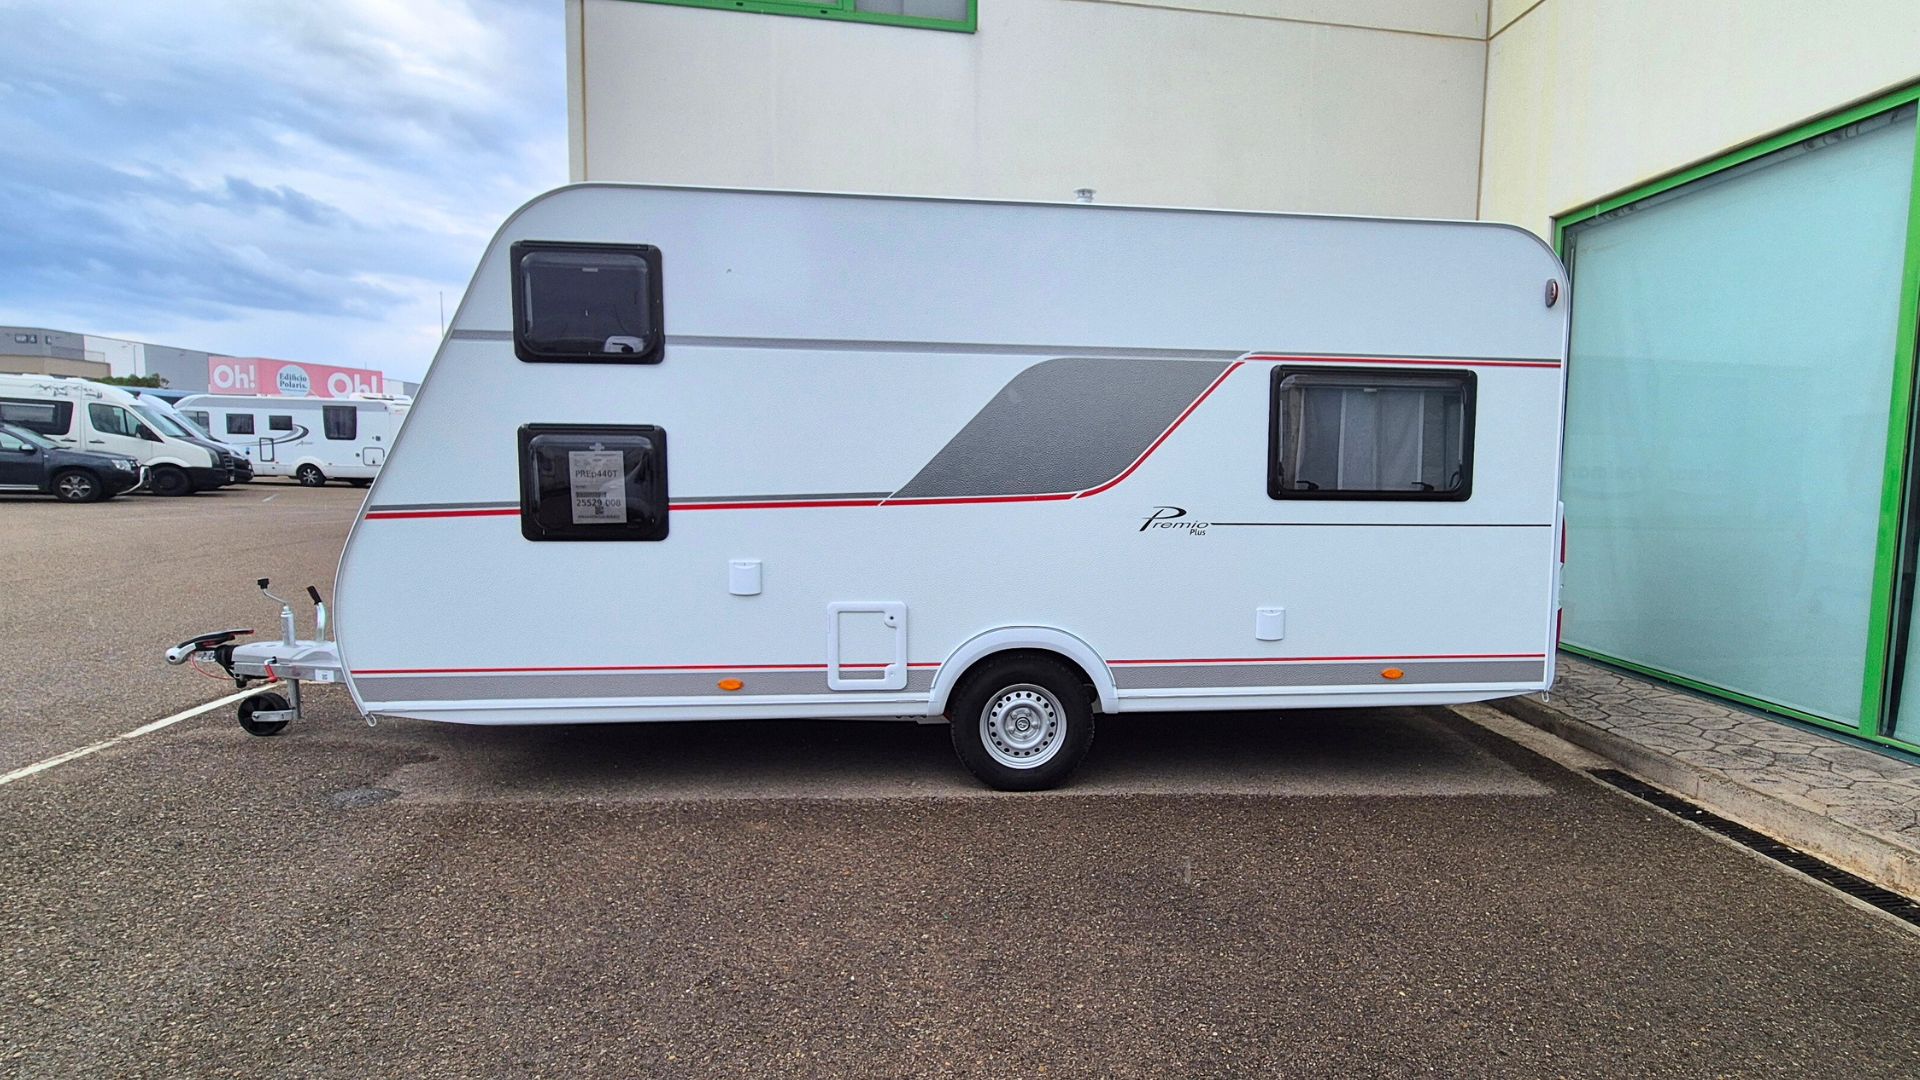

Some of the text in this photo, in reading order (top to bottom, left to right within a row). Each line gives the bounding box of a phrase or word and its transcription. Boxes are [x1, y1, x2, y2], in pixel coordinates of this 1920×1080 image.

[213, 365, 256, 389] Oh!
[279, 372, 308, 382] Edificio
[1139, 505, 1209, 532] Premio
